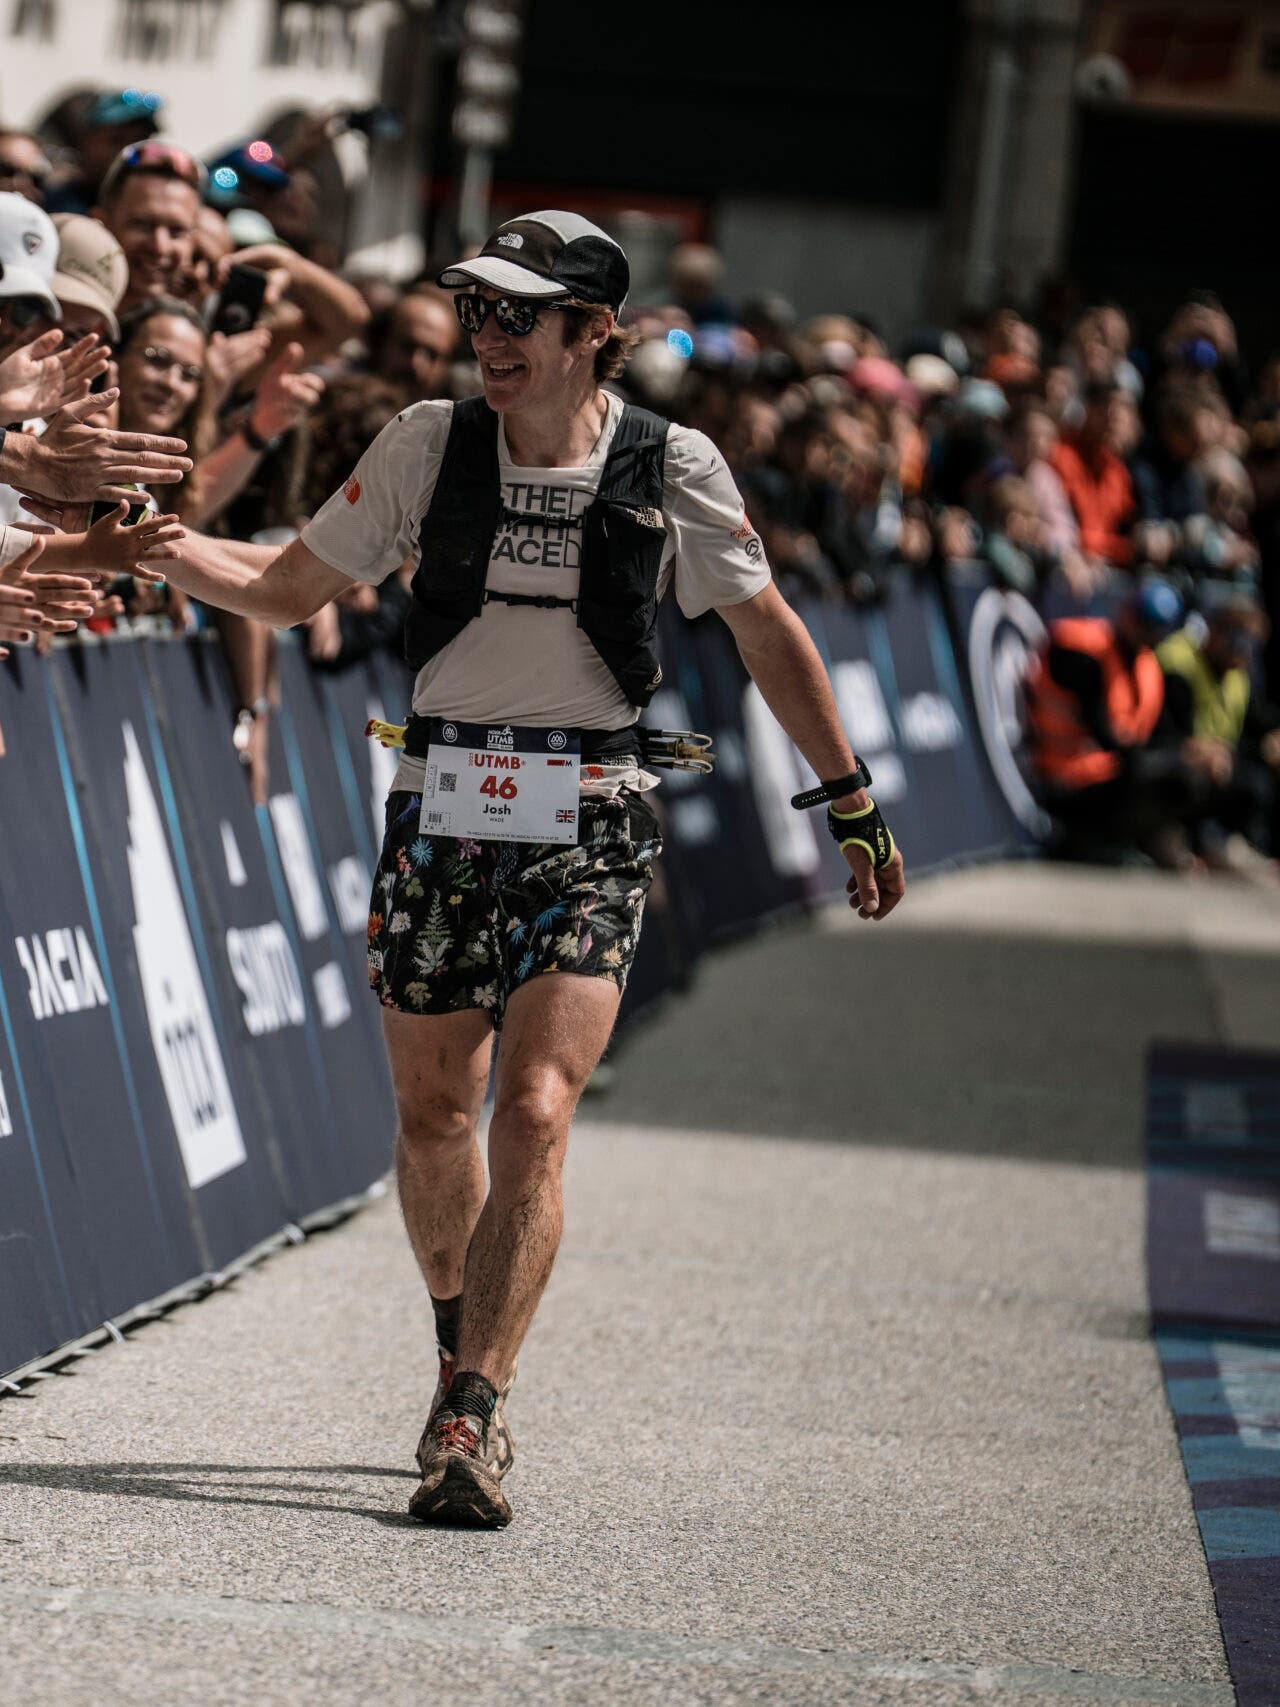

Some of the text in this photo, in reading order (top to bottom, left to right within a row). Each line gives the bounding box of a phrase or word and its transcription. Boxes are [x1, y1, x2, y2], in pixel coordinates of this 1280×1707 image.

[507, 483, 568, 514] THE
[491, 535, 562, 567] ACE
[487, 734, 514, 745] UTMB
[480, 775, 518, 800] 46
[483, 803, 511, 815] Josh
[876, 828, 886, 859] LEKI
[15, 926, 109, 1019] DACIA
